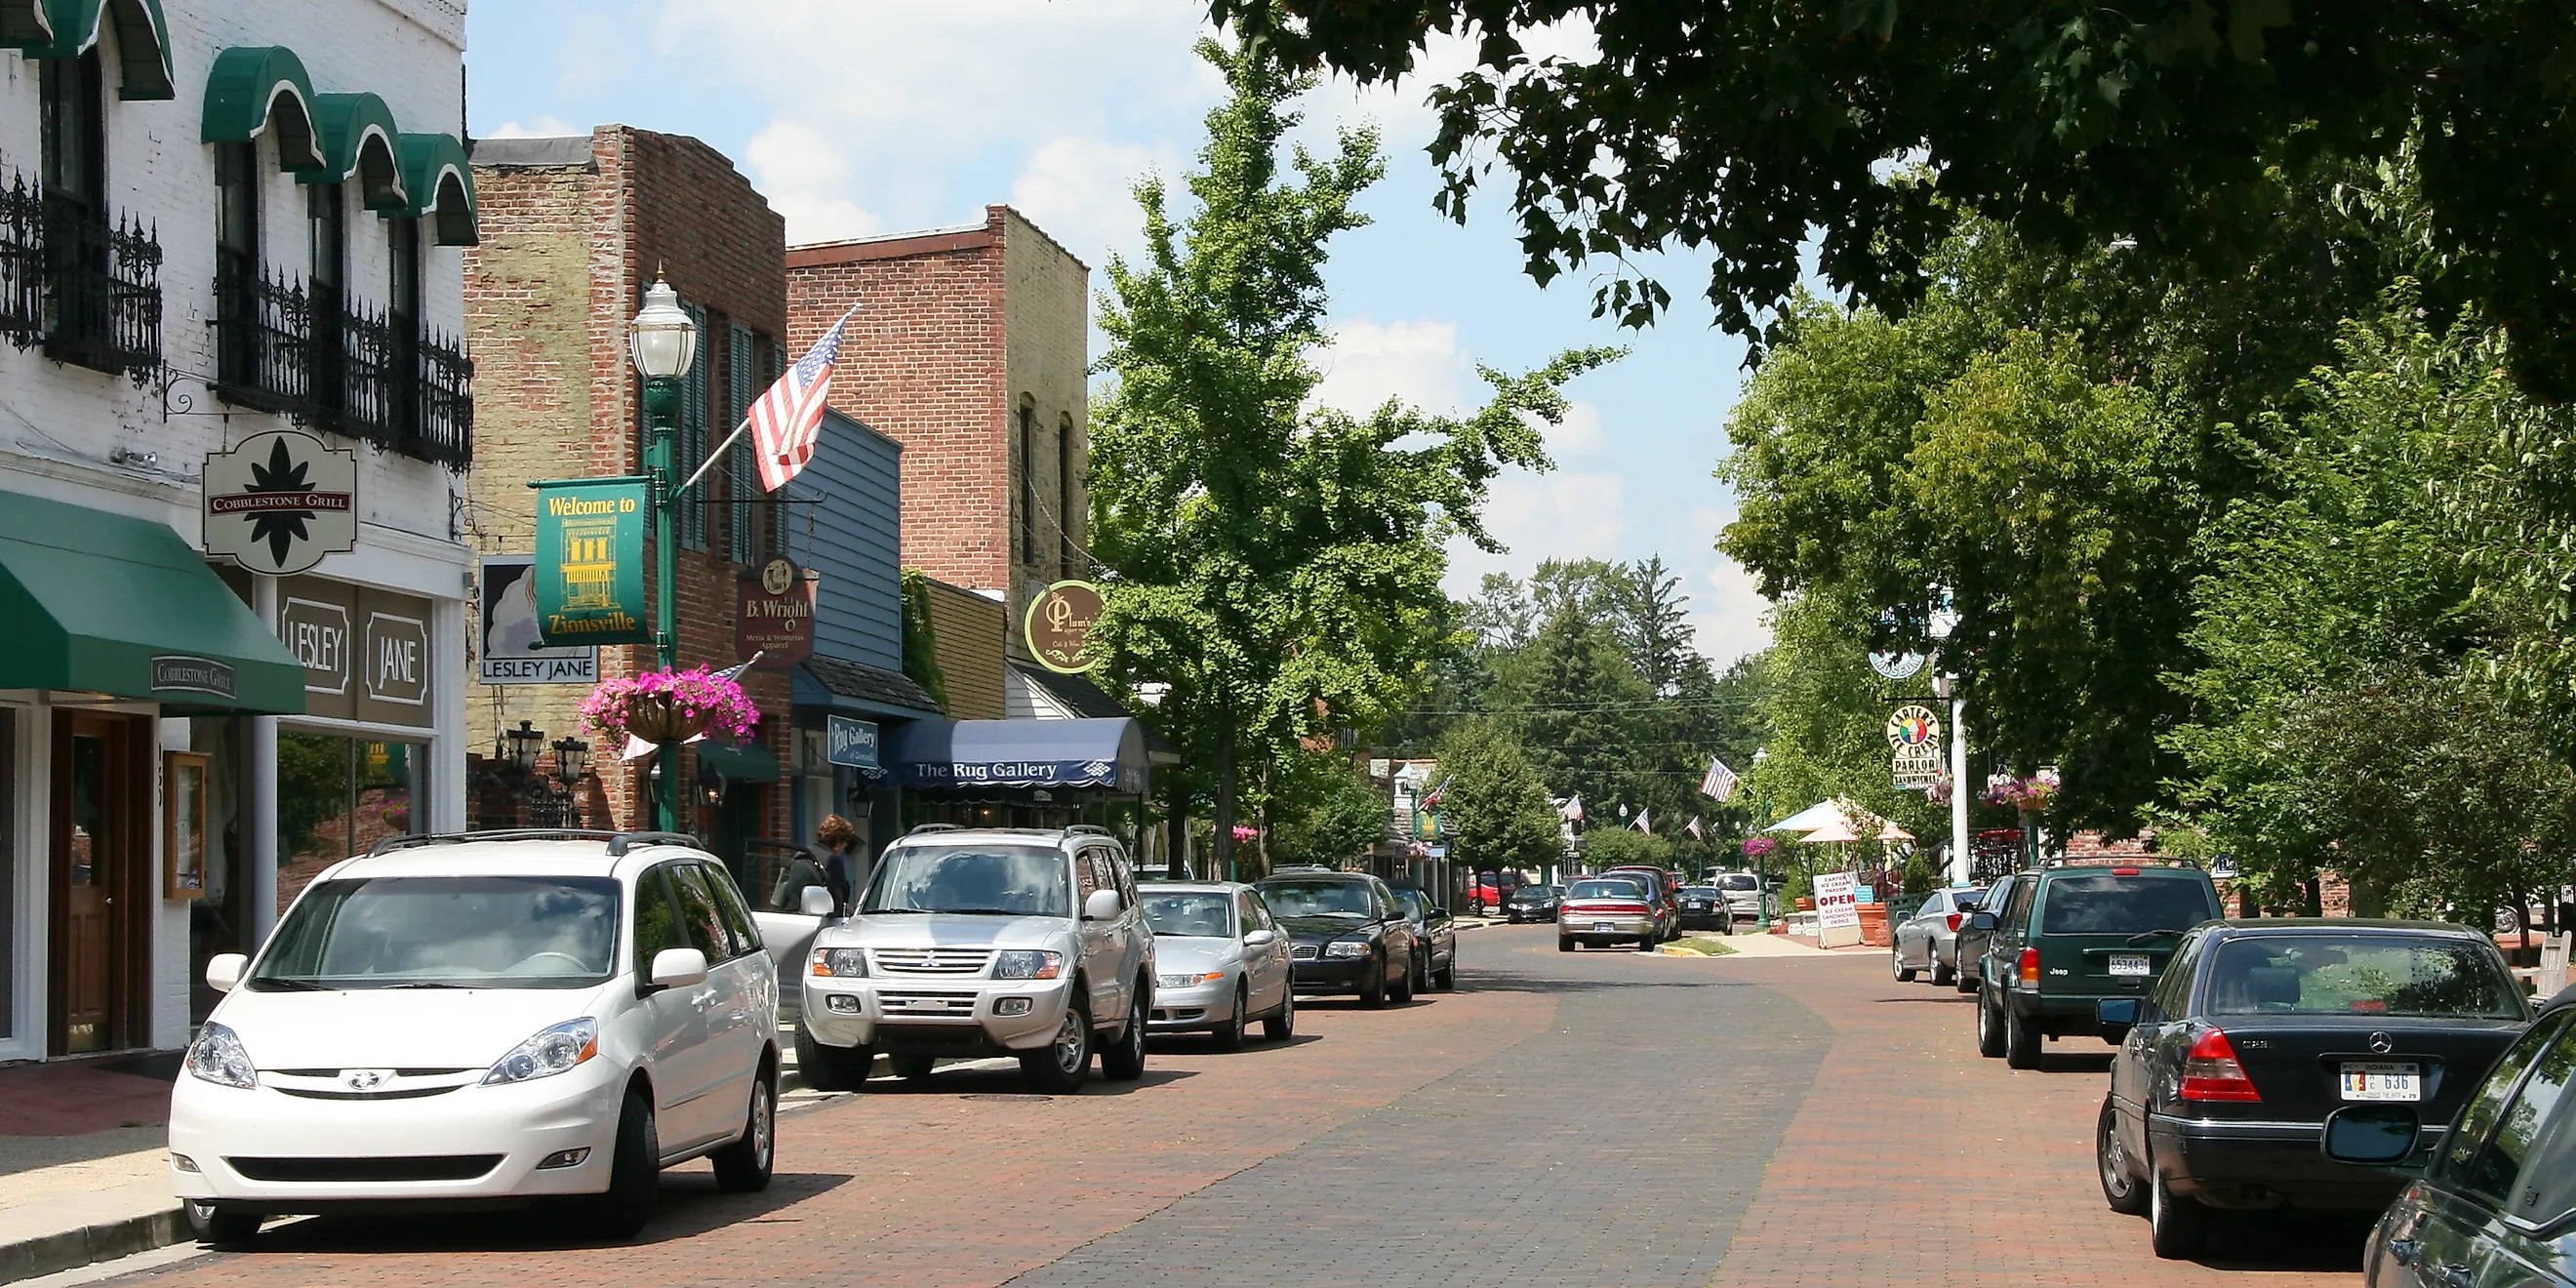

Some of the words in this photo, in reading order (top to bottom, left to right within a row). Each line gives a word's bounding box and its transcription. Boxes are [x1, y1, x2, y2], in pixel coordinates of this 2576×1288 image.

[213, 496, 301, 511] COBBLESTONE
[305, 494, 345, 508] GRILL
[548, 495, 616, 516] Welcome
[619, 497, 636, 513] to
[548, 611, 636, 635] Zionsville
[746, 600, 759, 618] B.
[762, 597, 808, 632] Wright
[762, 642, 788, 651] Apparel
[378, 636, 417, 690] JANE
[483, 661, 544, 677] LESLEY
[547, 661, 592, 680] JANE
[1874, 656, 1921, 676] MUSEUM
[158, 664, 209, 683] COBBLESTONE
[1891, 707, 1936, 728] CARTER'S
[834, 723, 848, 755] Rug
[849, 726, 875, 748] Gallery
[1890, 733, 1905, 751] ICE
[1908, 733, 1938, 758] CREAM
[915, 763, 947, 778] The
[953, 763, 987, 780] Rug
[992, 762, 1058, 780] Gallery
[1895, 759, 1935, 771] PARLOR
[1820, 893, 1856, 906] OPEN
[2385, 1073, 2409, 1090] 636
